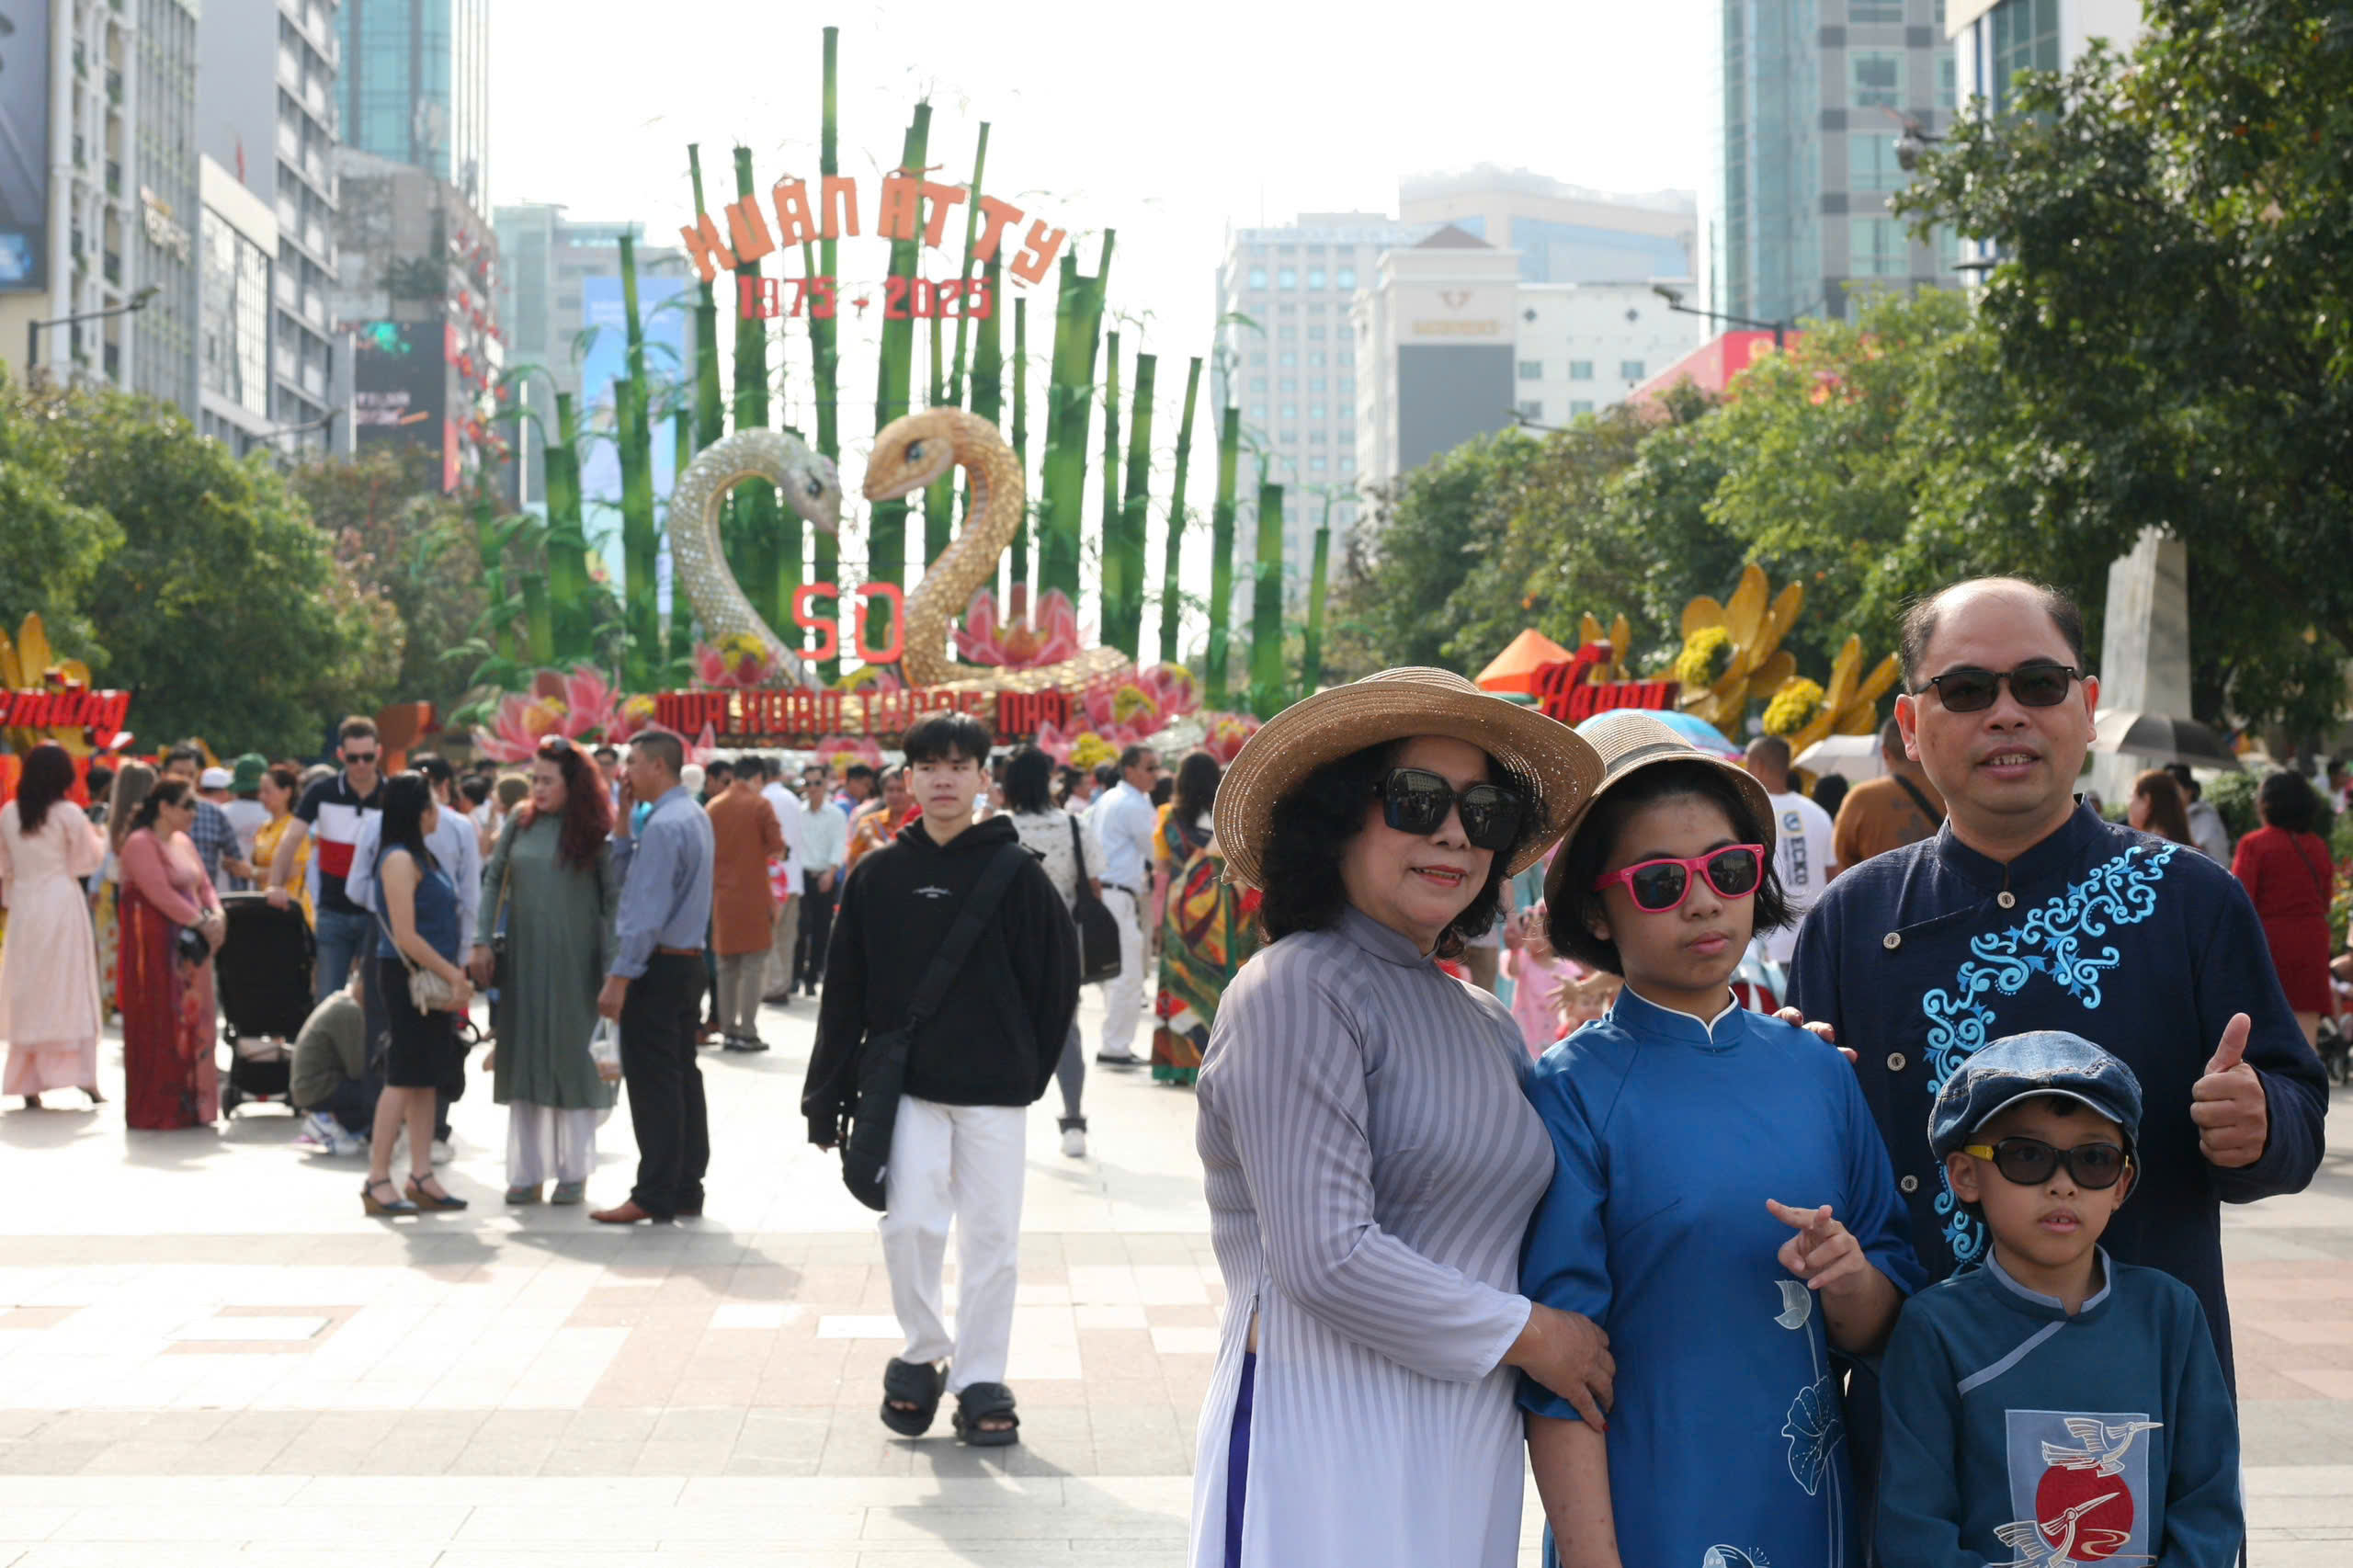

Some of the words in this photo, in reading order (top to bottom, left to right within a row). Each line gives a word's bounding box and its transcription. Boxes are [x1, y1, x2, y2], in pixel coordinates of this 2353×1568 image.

[737, 275, 836, 319] 1975
[883, 275, 992, 319] 2025
[1530, 641, 1673, 722] Happy
